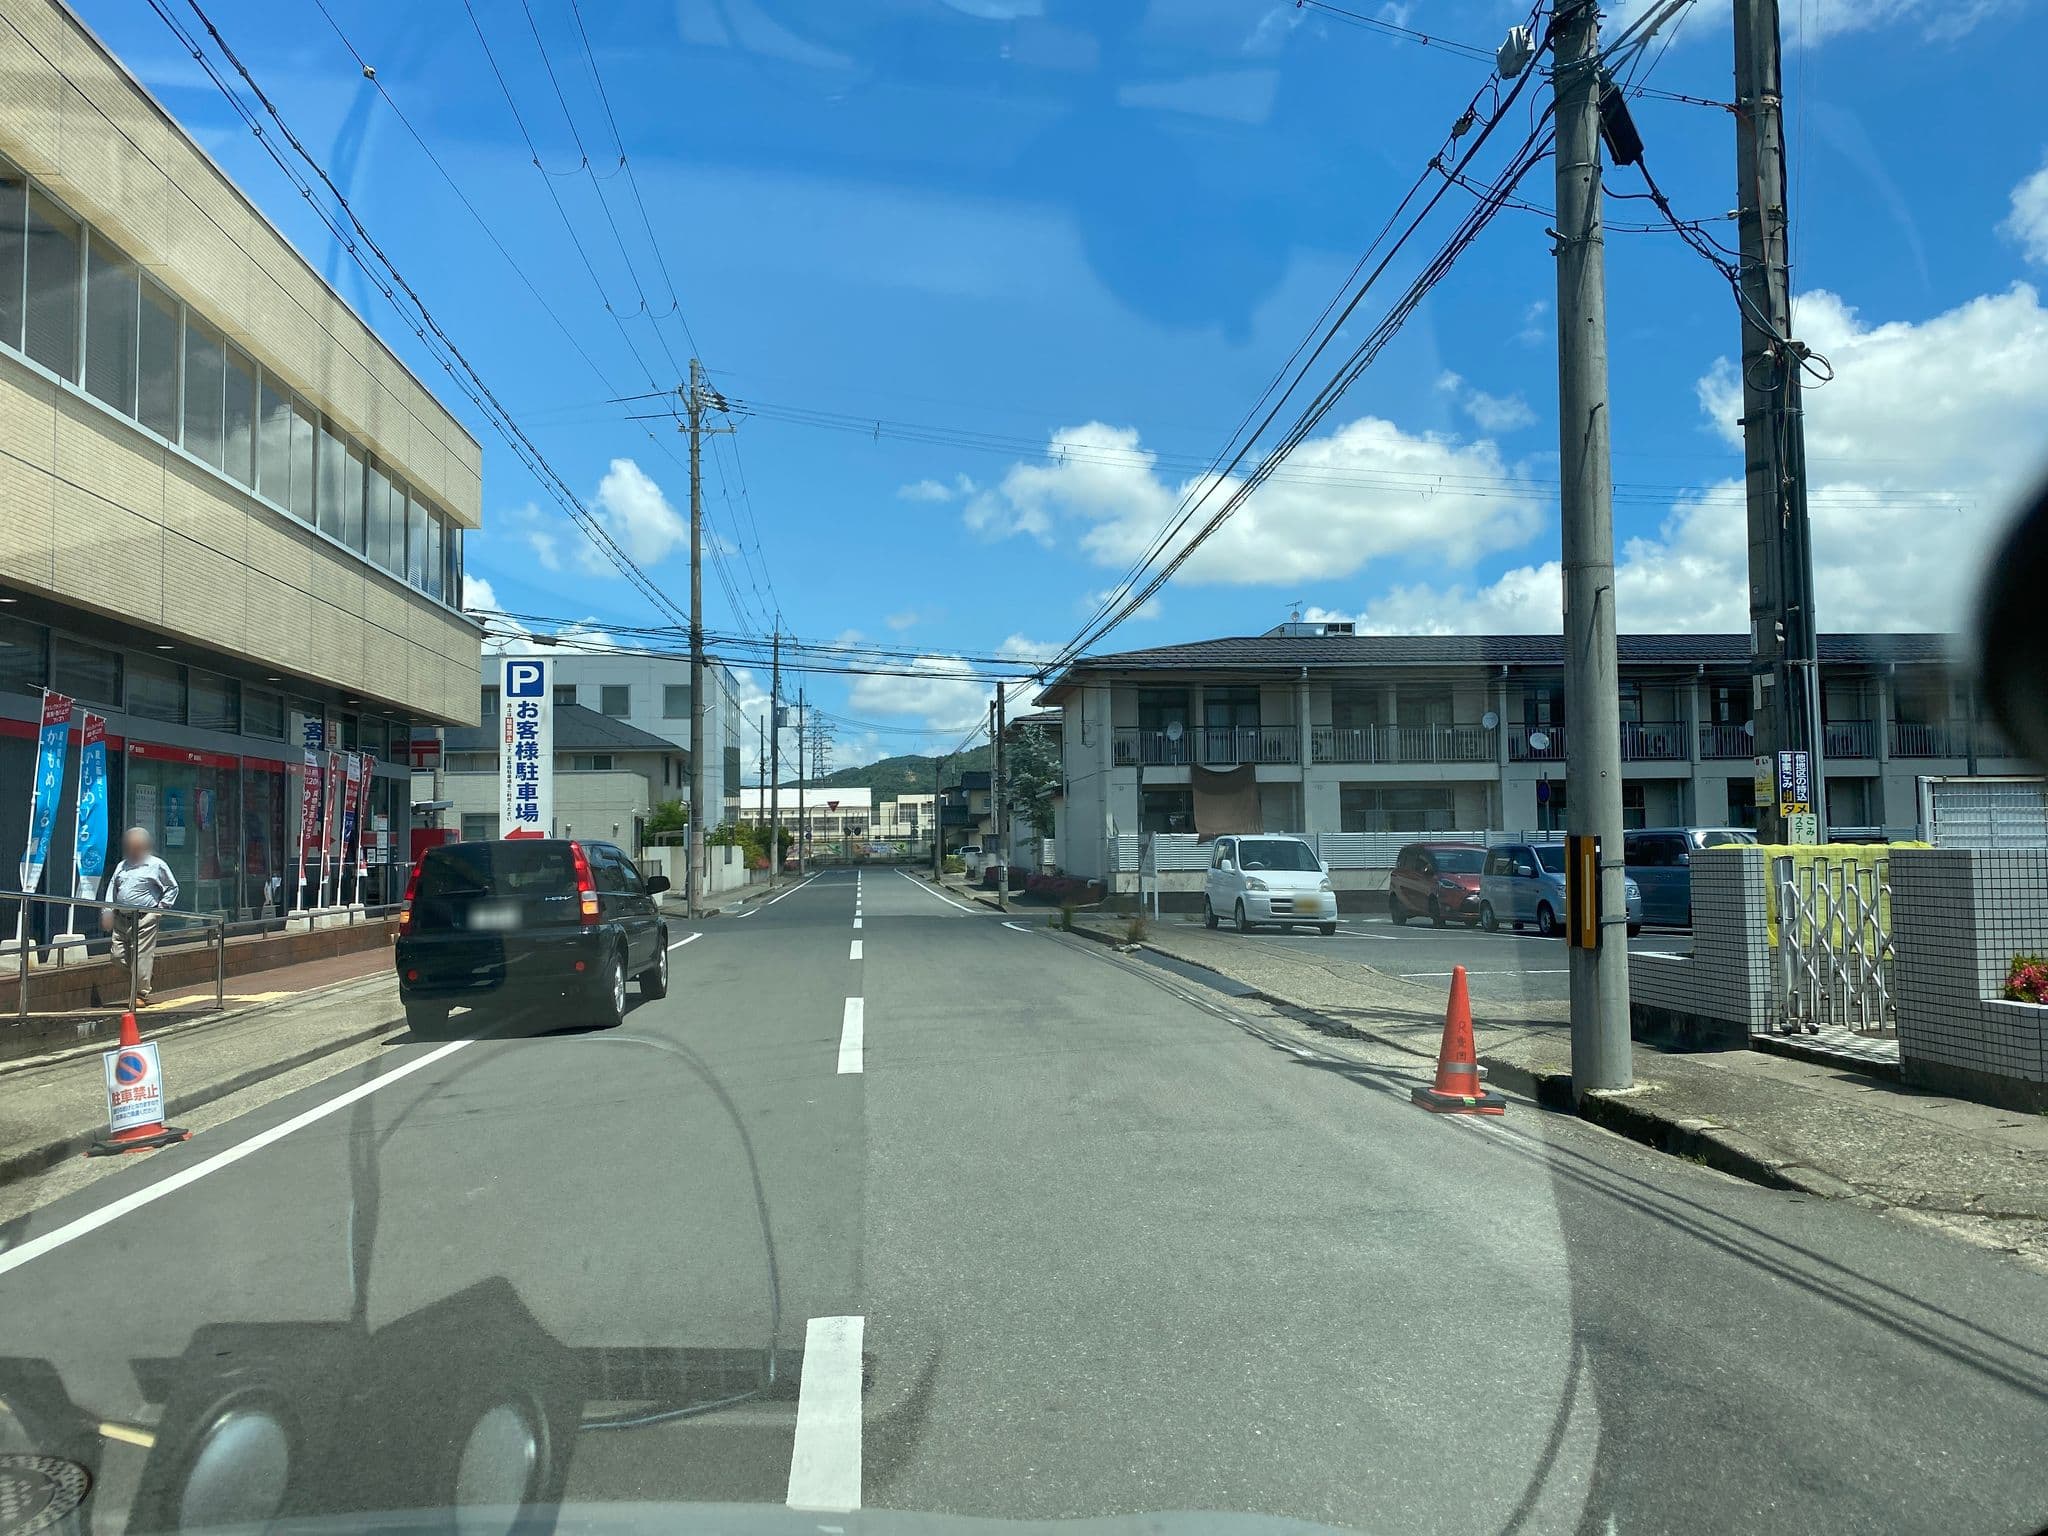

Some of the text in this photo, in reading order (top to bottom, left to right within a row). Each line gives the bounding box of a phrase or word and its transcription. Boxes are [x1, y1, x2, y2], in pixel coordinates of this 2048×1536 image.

[513, 666, 540, 693] P
[515, 701, 539, 823] お客様駐車場
[1795, 754, 1807, 801] 他地区の持込
[112, 1084, 159, 1107] 駐車禁止
